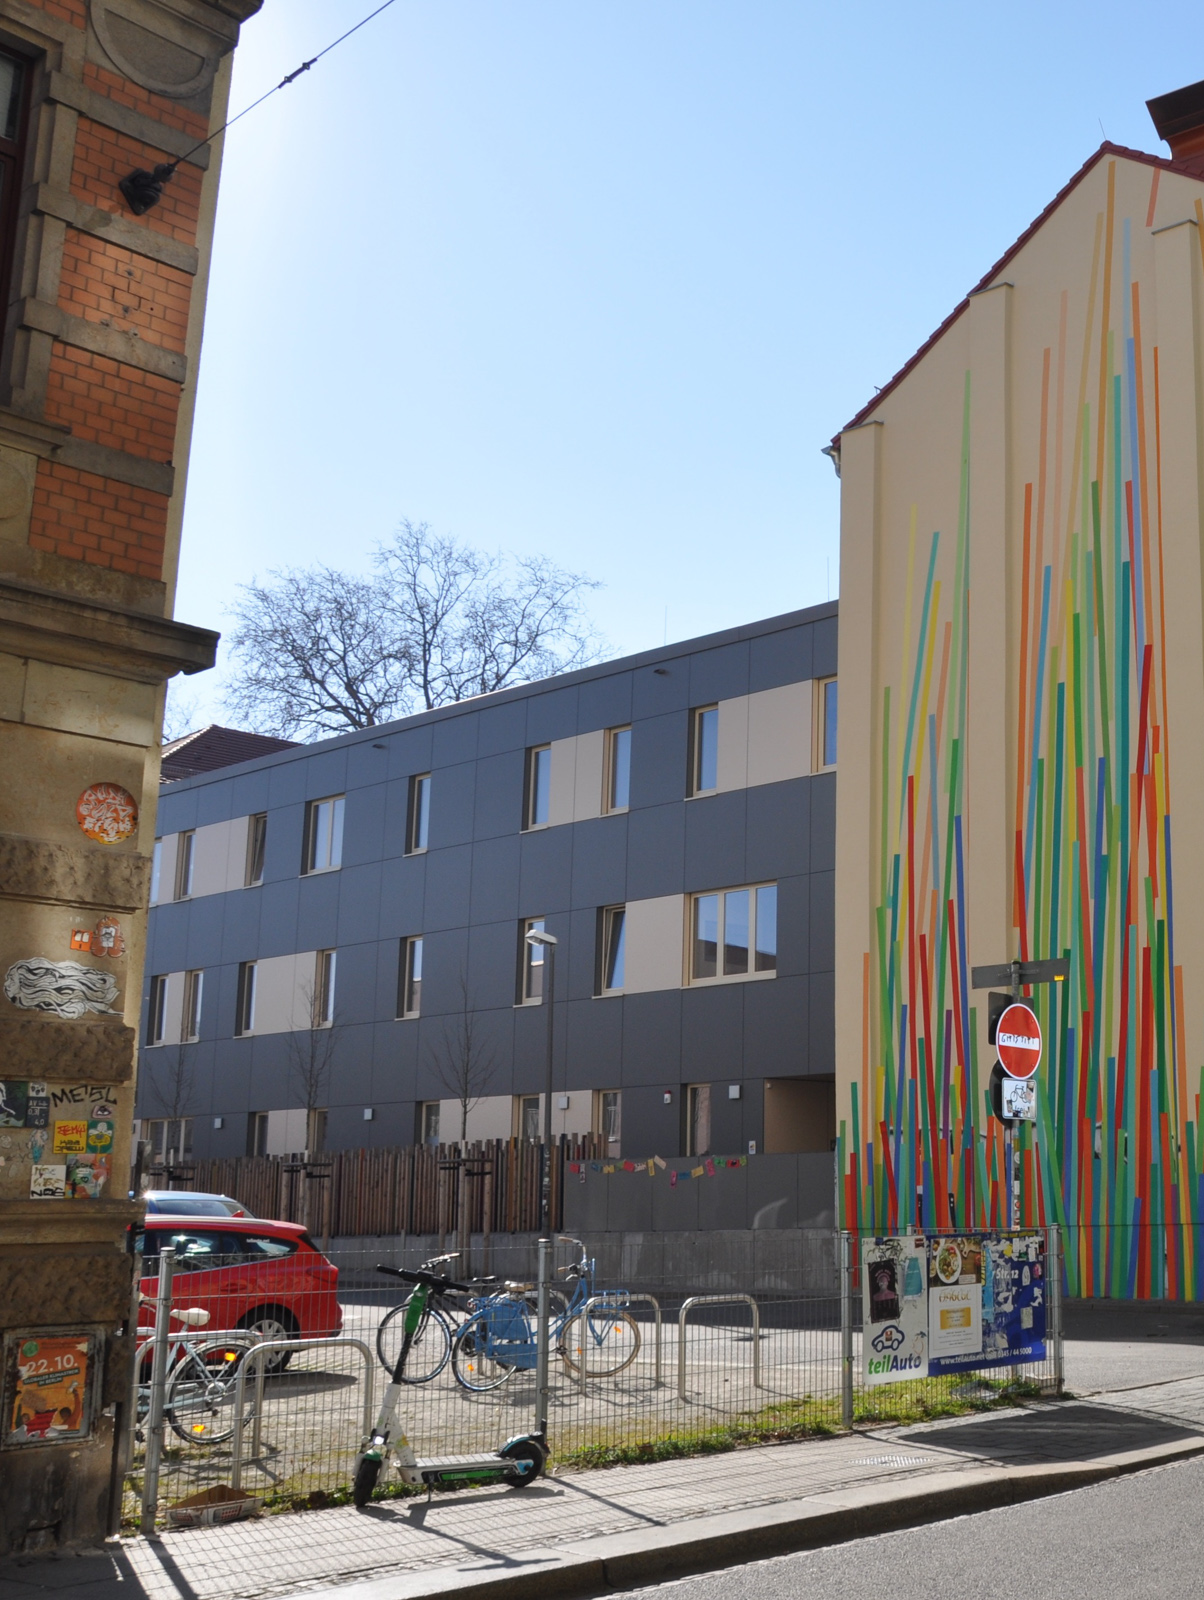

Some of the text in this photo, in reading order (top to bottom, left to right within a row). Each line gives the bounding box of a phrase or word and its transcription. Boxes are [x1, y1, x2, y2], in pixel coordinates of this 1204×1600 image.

[996, 1268, 1019, 1279] Str. 12
[25, 1354, 79, 1376] 22.10.
[867, 1353, 922, 1375] teilAuto
[45, 1376, 62, 1384] BERLIN
